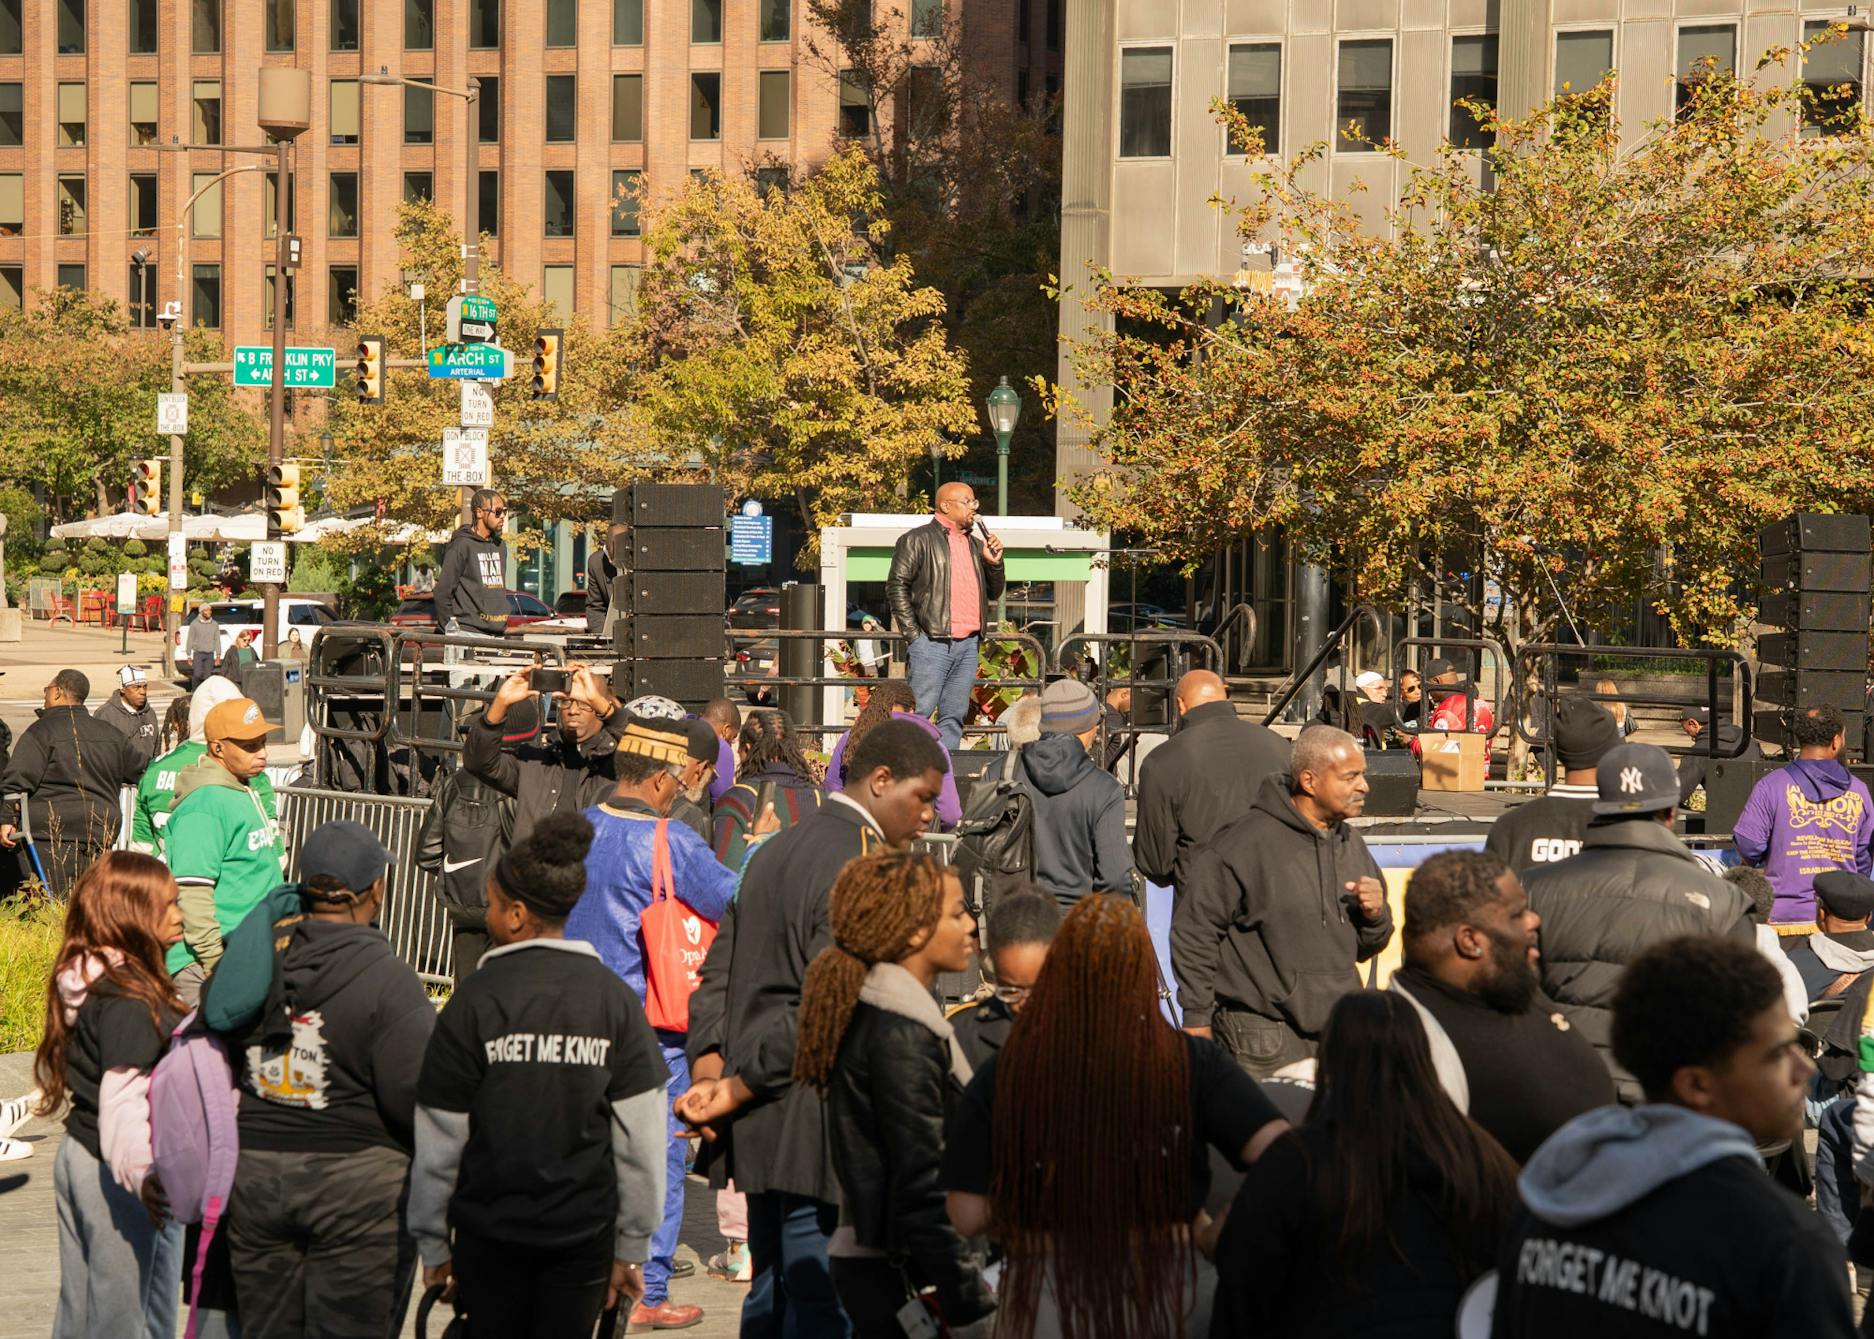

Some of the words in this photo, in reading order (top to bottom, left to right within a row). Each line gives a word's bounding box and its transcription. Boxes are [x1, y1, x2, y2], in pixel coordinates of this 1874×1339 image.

[488, 308, 496, 318] ST
[248, 352, 256, 365] B
[260, 352, 308, 366] FRKLIN
[312, 353, 333, 367] PKY
[447, 352, 484, 365] ARCH
[488, 354, 500, 364] ST
[261, 368, 290, 381] AH
[295, 369, 308, 382] ST
[450, 368, 485, 376] ARTERIAL
[472, 387, 484, 396] NO
[468, 399, 487, 408] TURN
[464, 411, 473, 420] ON
[476, 412, 490, 421] RED
[465, 431, 485, 441] BLOCK
[446, 471, 462, 481] THE
[466, 471, 483, 481] BOX
[262, 546, 274, 555] NO
[257, 557, 279, 565] TURN
[253, 568, 264, 576] ON
[266, 568, 282, 576] RED
[537, 1034, 563, 1063] ME
[564, 1035, 611, 1067] KNOT
[1516, 1237, 1604, 1296] FORGET
[1597, 1254, 1641, 1311] ME
[1639, 1266, 1716, 1337] KNOT
